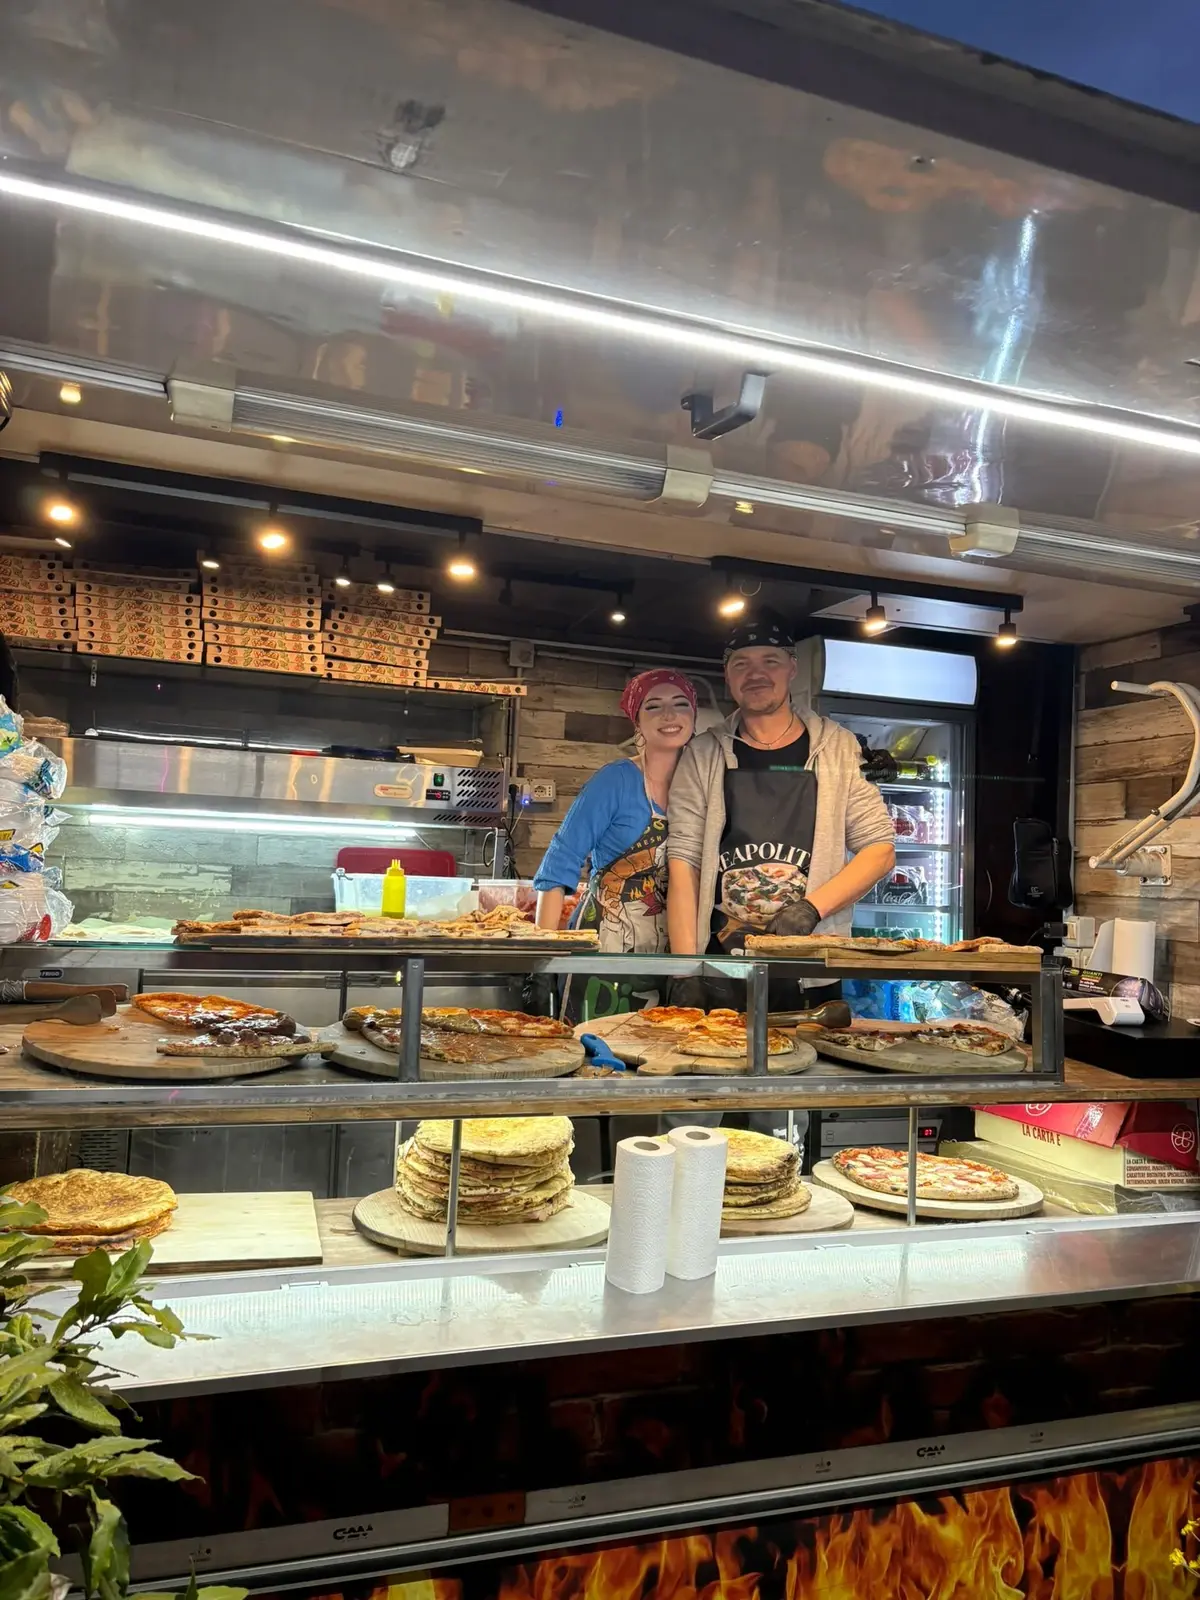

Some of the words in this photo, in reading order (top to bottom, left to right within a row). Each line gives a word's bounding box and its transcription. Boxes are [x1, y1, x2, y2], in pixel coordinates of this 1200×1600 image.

[718, 841, 811, 873] EAPOLIT
[1022, 1124, 1031, 1136] LA
[1032, 1127, 1055, 1144] CARTA
